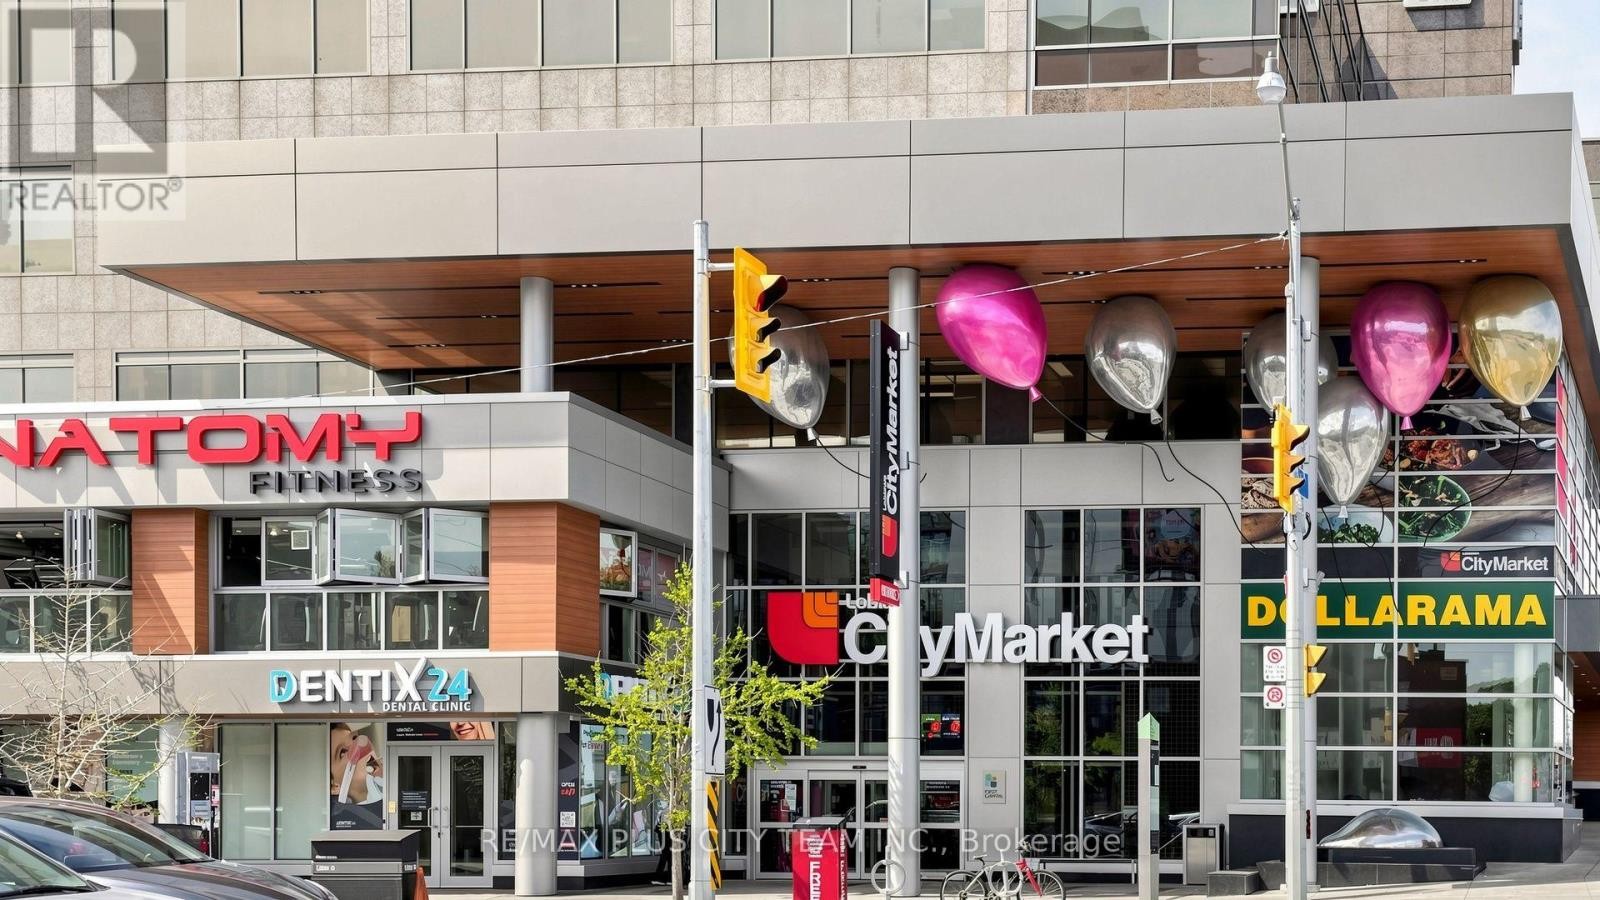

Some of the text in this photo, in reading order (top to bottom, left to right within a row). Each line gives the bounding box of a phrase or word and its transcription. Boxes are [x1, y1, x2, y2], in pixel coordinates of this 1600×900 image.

[886, 346, 900, 515] CityMarket
[249, 468, 423, 495] FITNESS
[1461, 556, 1549, 575] CityMarket
[1247, 594, 1547, 627] DLLARAMA
[843, 611, 1150, 677] CyMarket
[382, 701, 472, 712] DENTAL CLINIC
